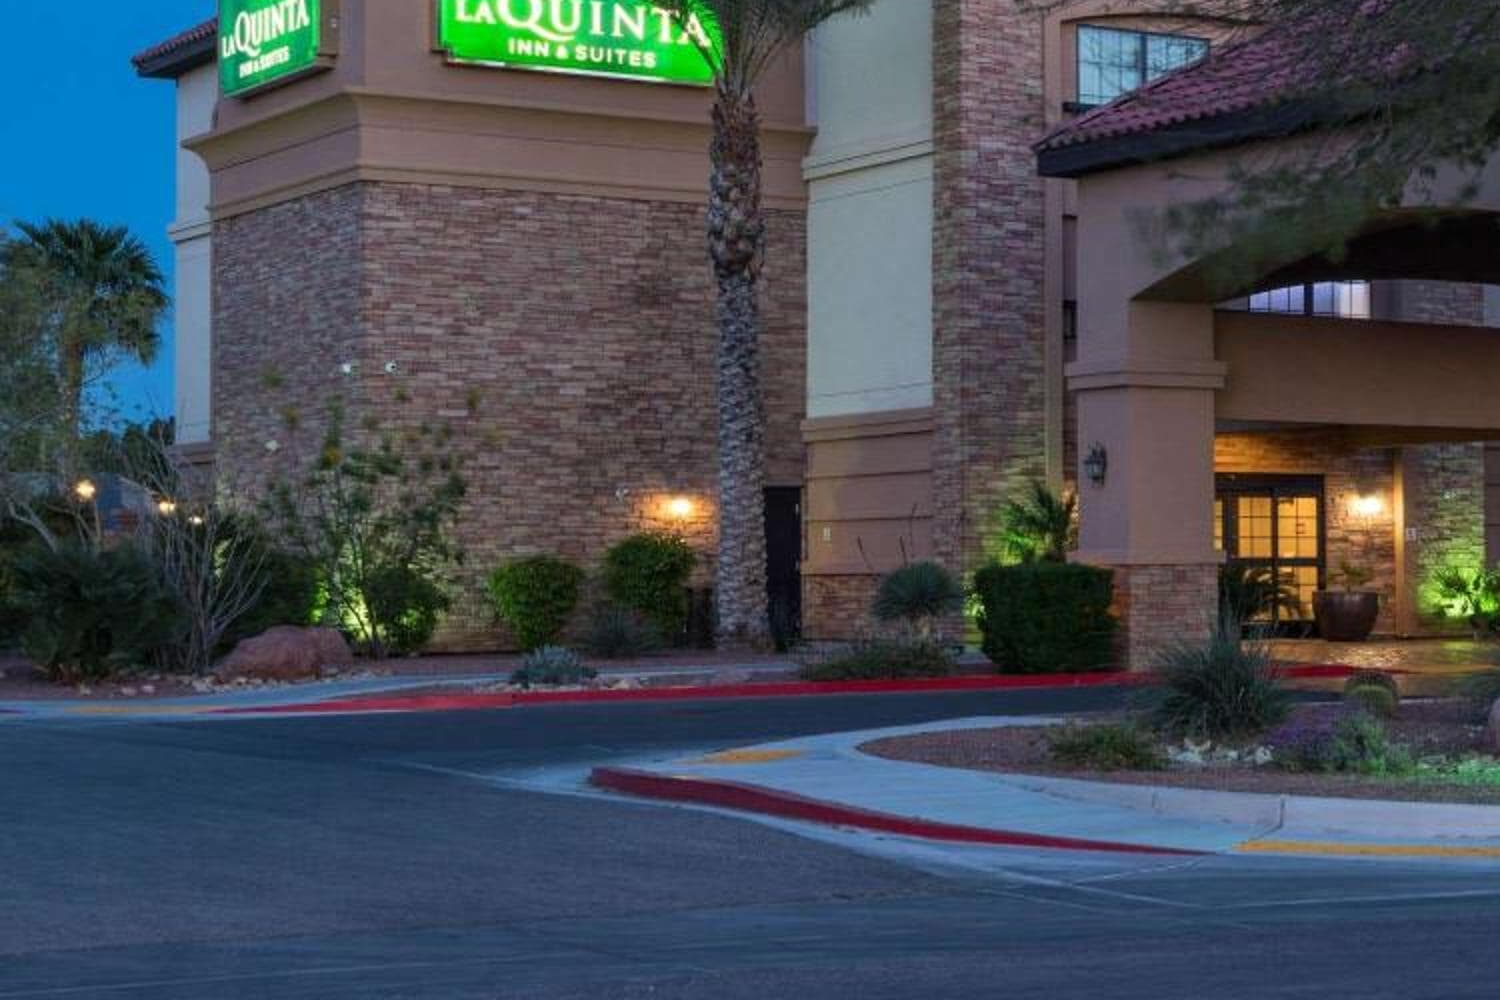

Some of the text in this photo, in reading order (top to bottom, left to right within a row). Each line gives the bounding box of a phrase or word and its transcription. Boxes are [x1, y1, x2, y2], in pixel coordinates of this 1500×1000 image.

[222, 36, 236, 58] LA
[508, 37, 657, 68] INN & SUITES
